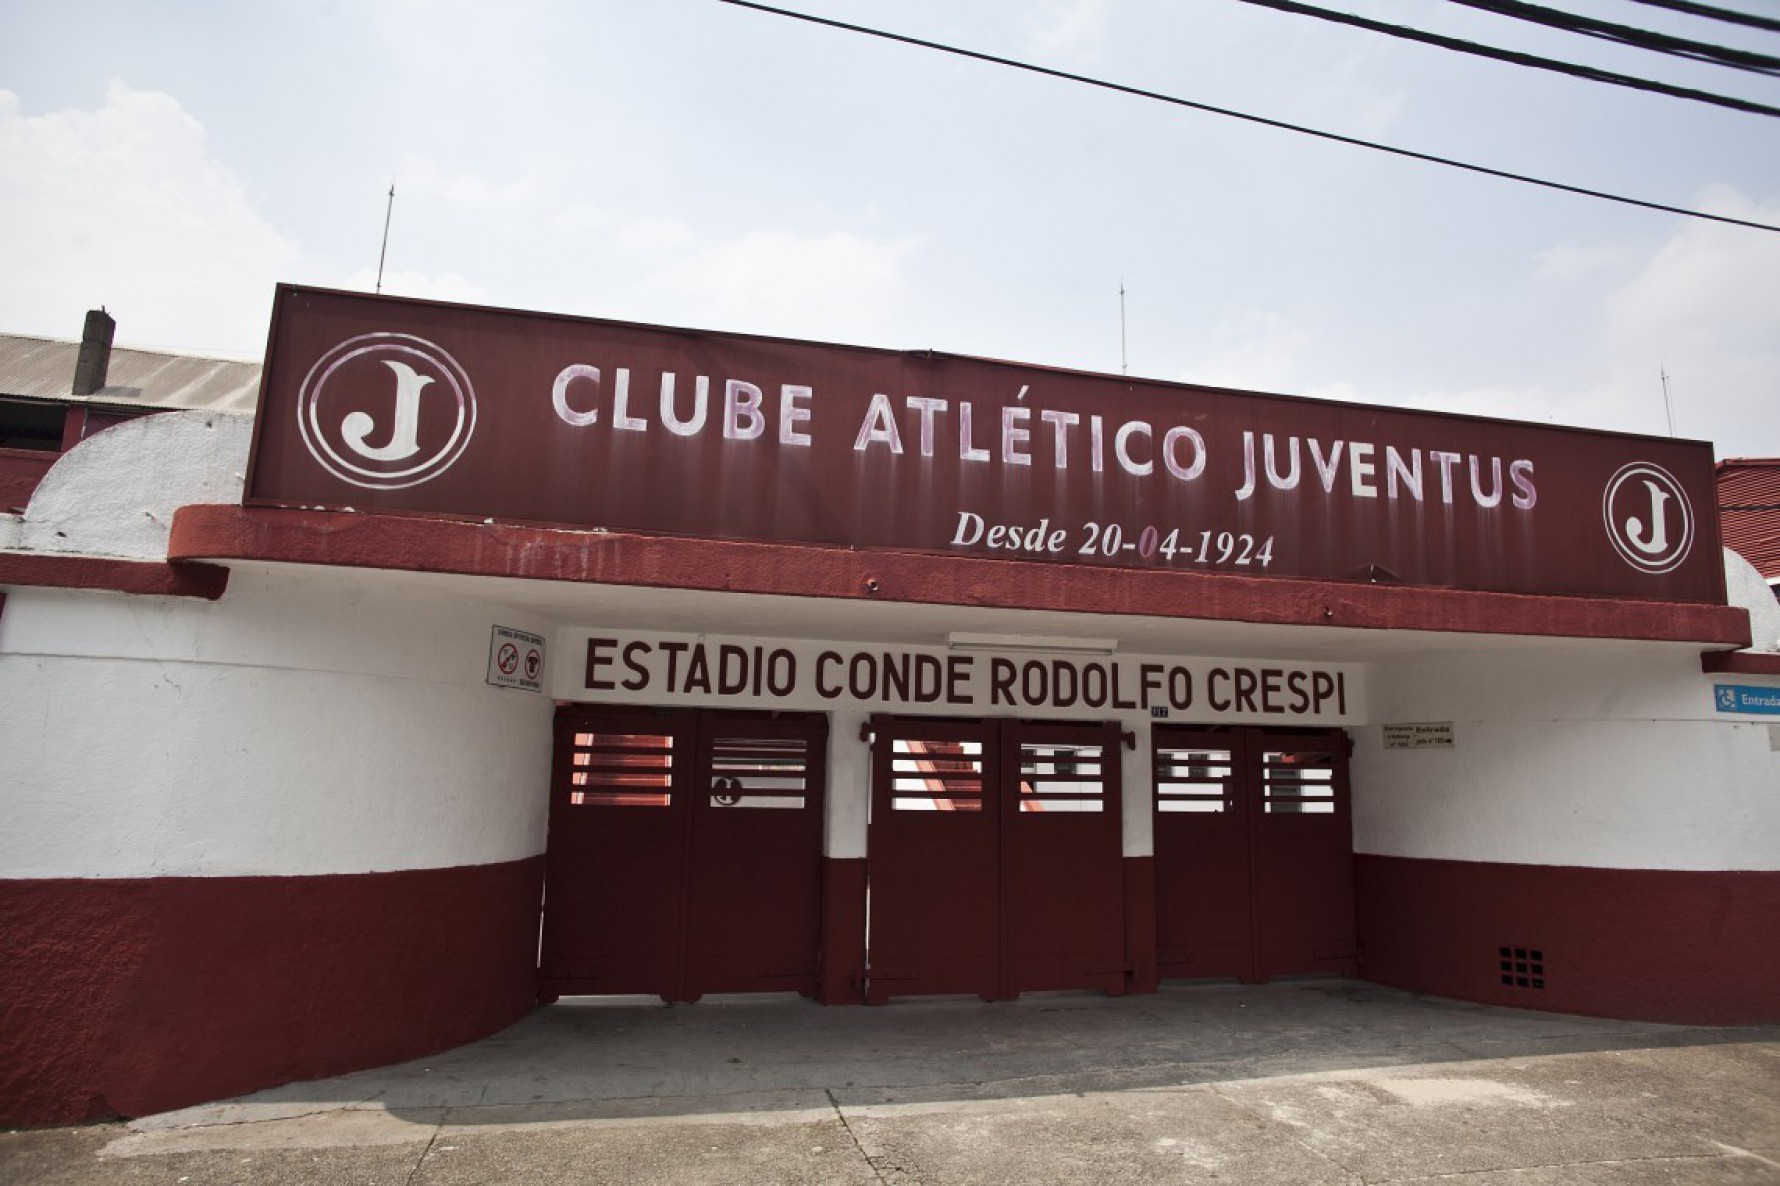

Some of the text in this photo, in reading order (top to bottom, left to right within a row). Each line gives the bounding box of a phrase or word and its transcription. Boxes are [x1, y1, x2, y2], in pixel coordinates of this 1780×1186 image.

[341, 360, 436, 462] J
[552, 363, 1537, 510] CLUBE ATLÉTICO JUVENTUS
[950, 511, 1274, 568] Desde 20-04-1924
[1625, 480, 1671, 554] J
[584, 637, 1346, 716] ESTADIO CONDE RODOLFO CRESPI
